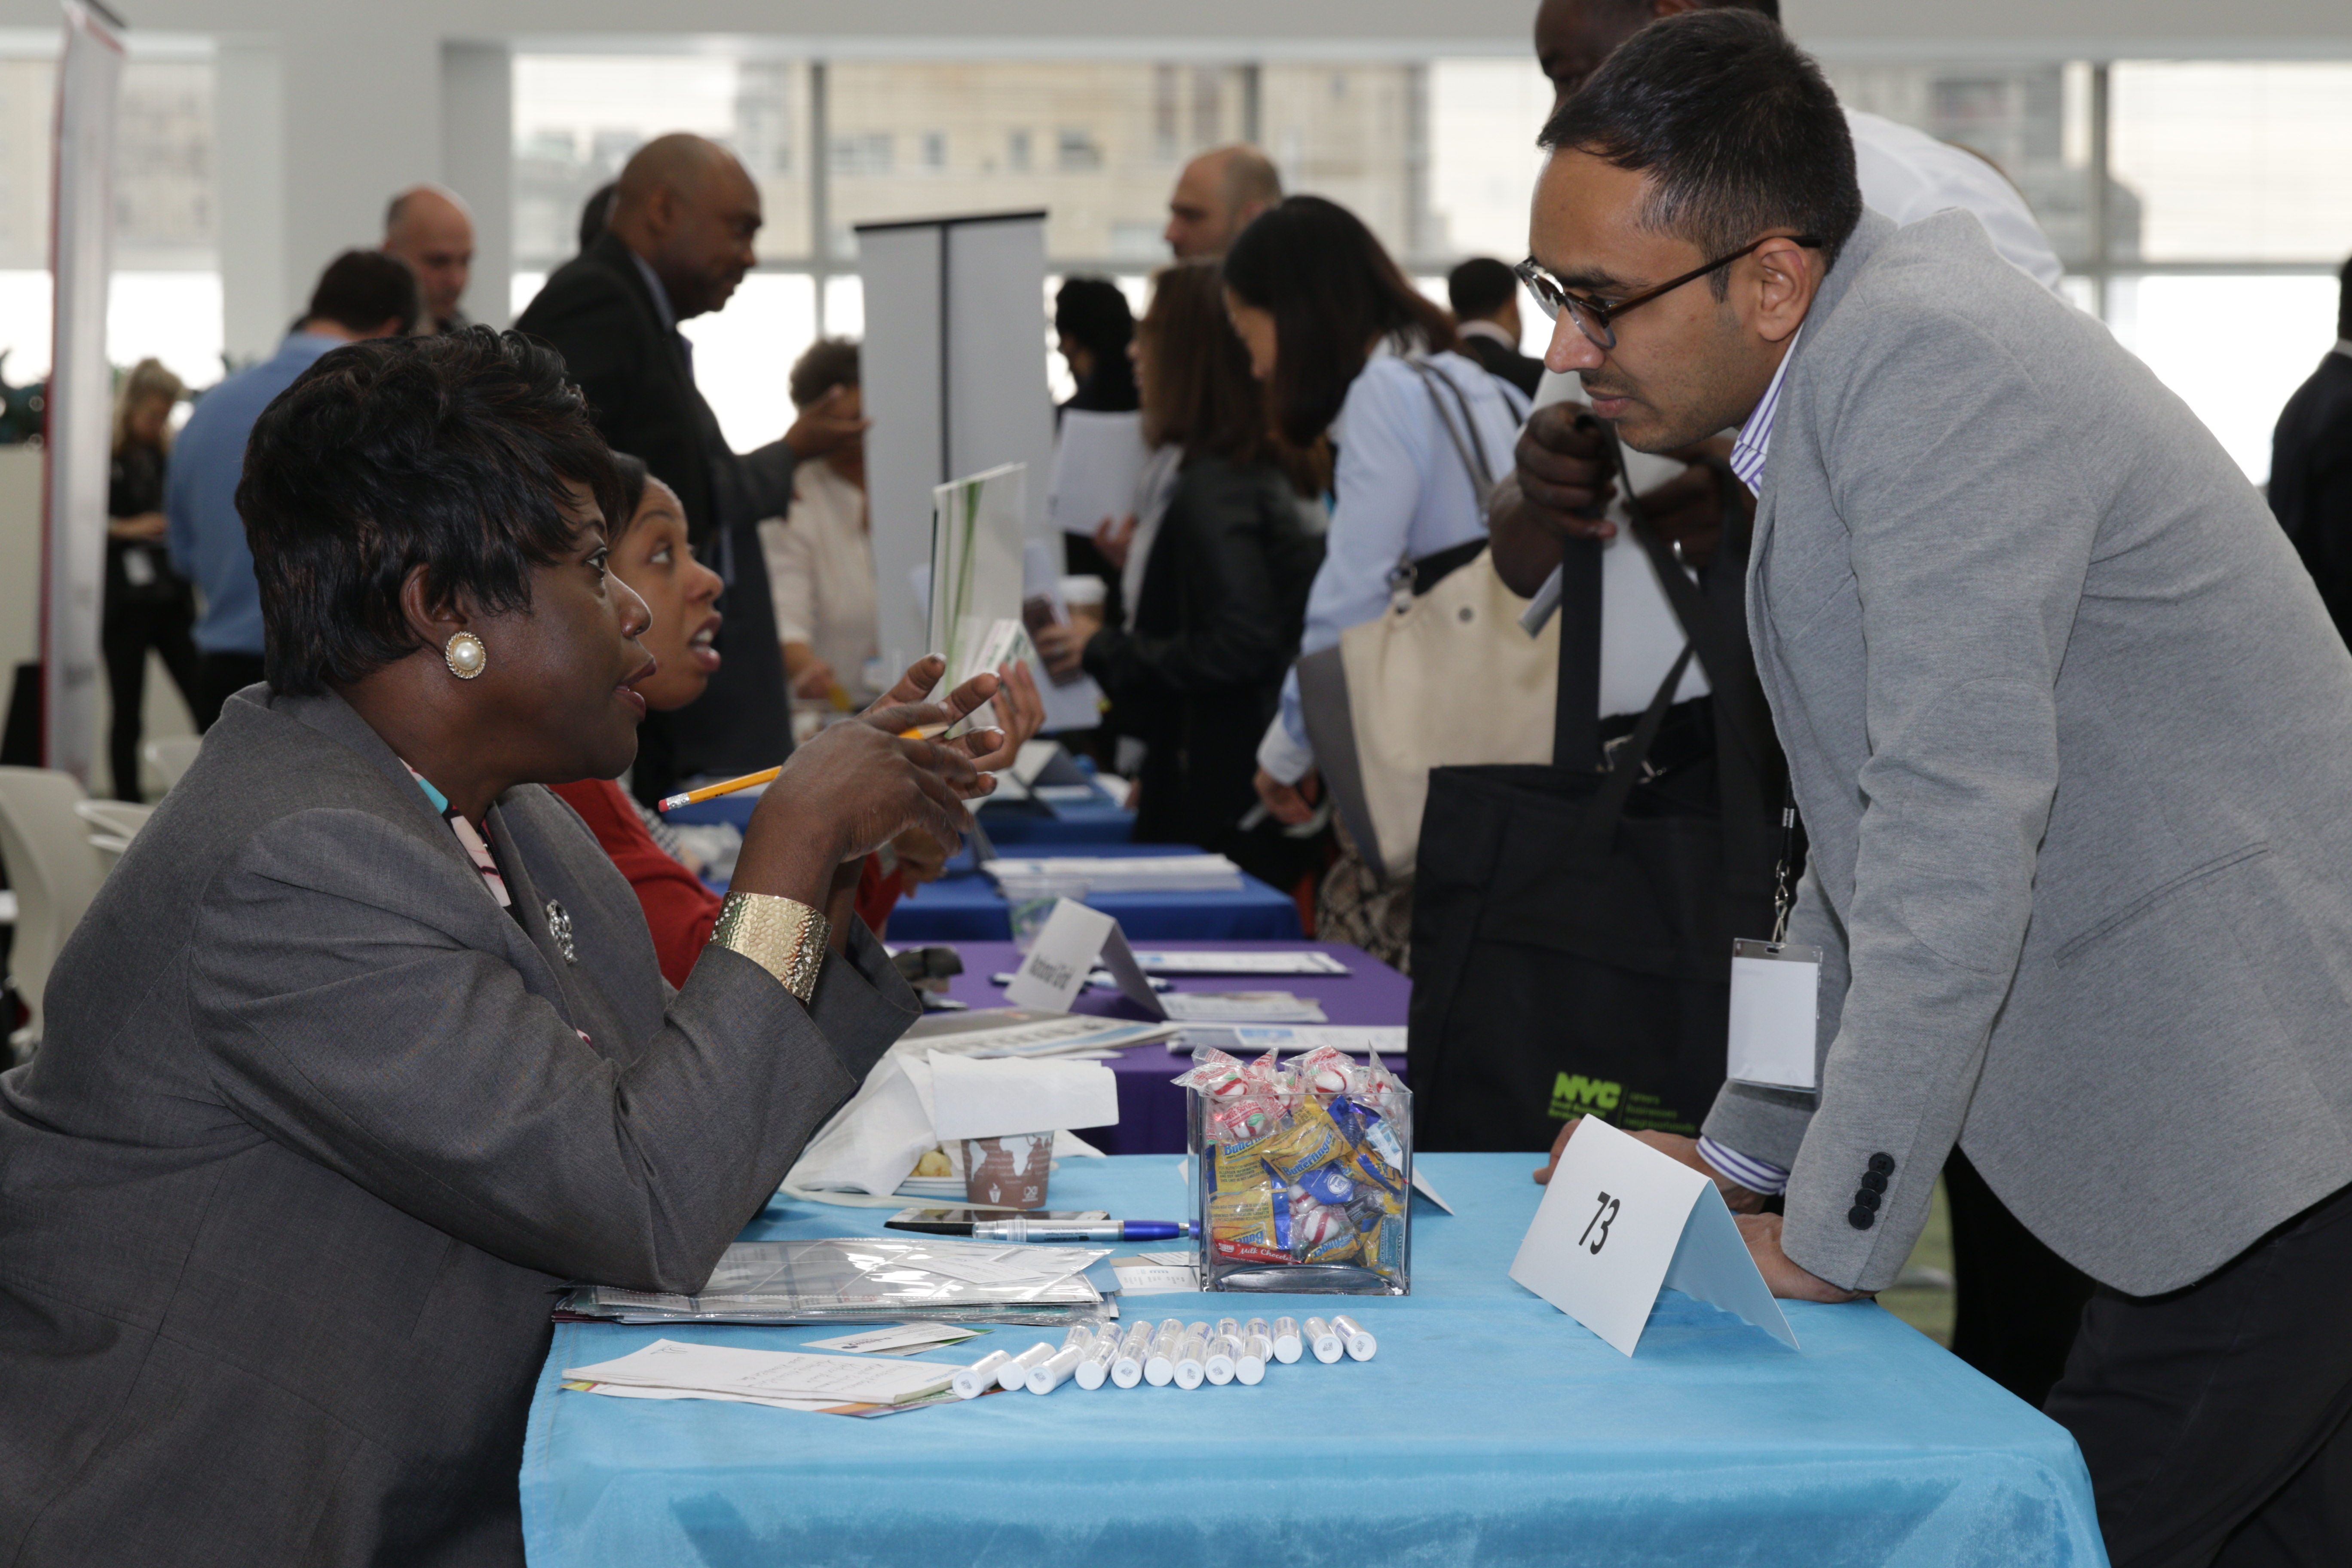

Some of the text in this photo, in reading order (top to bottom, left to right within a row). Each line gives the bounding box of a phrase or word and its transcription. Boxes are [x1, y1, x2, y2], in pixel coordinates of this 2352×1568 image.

[1237, 1101, 1259, 1114] Stripes
[1553, 1072, 1621, 1109] NYC
[1281, 1129, 1333, 1175] Butterfinger
[1578, 1191, 1620, 1255] 73
